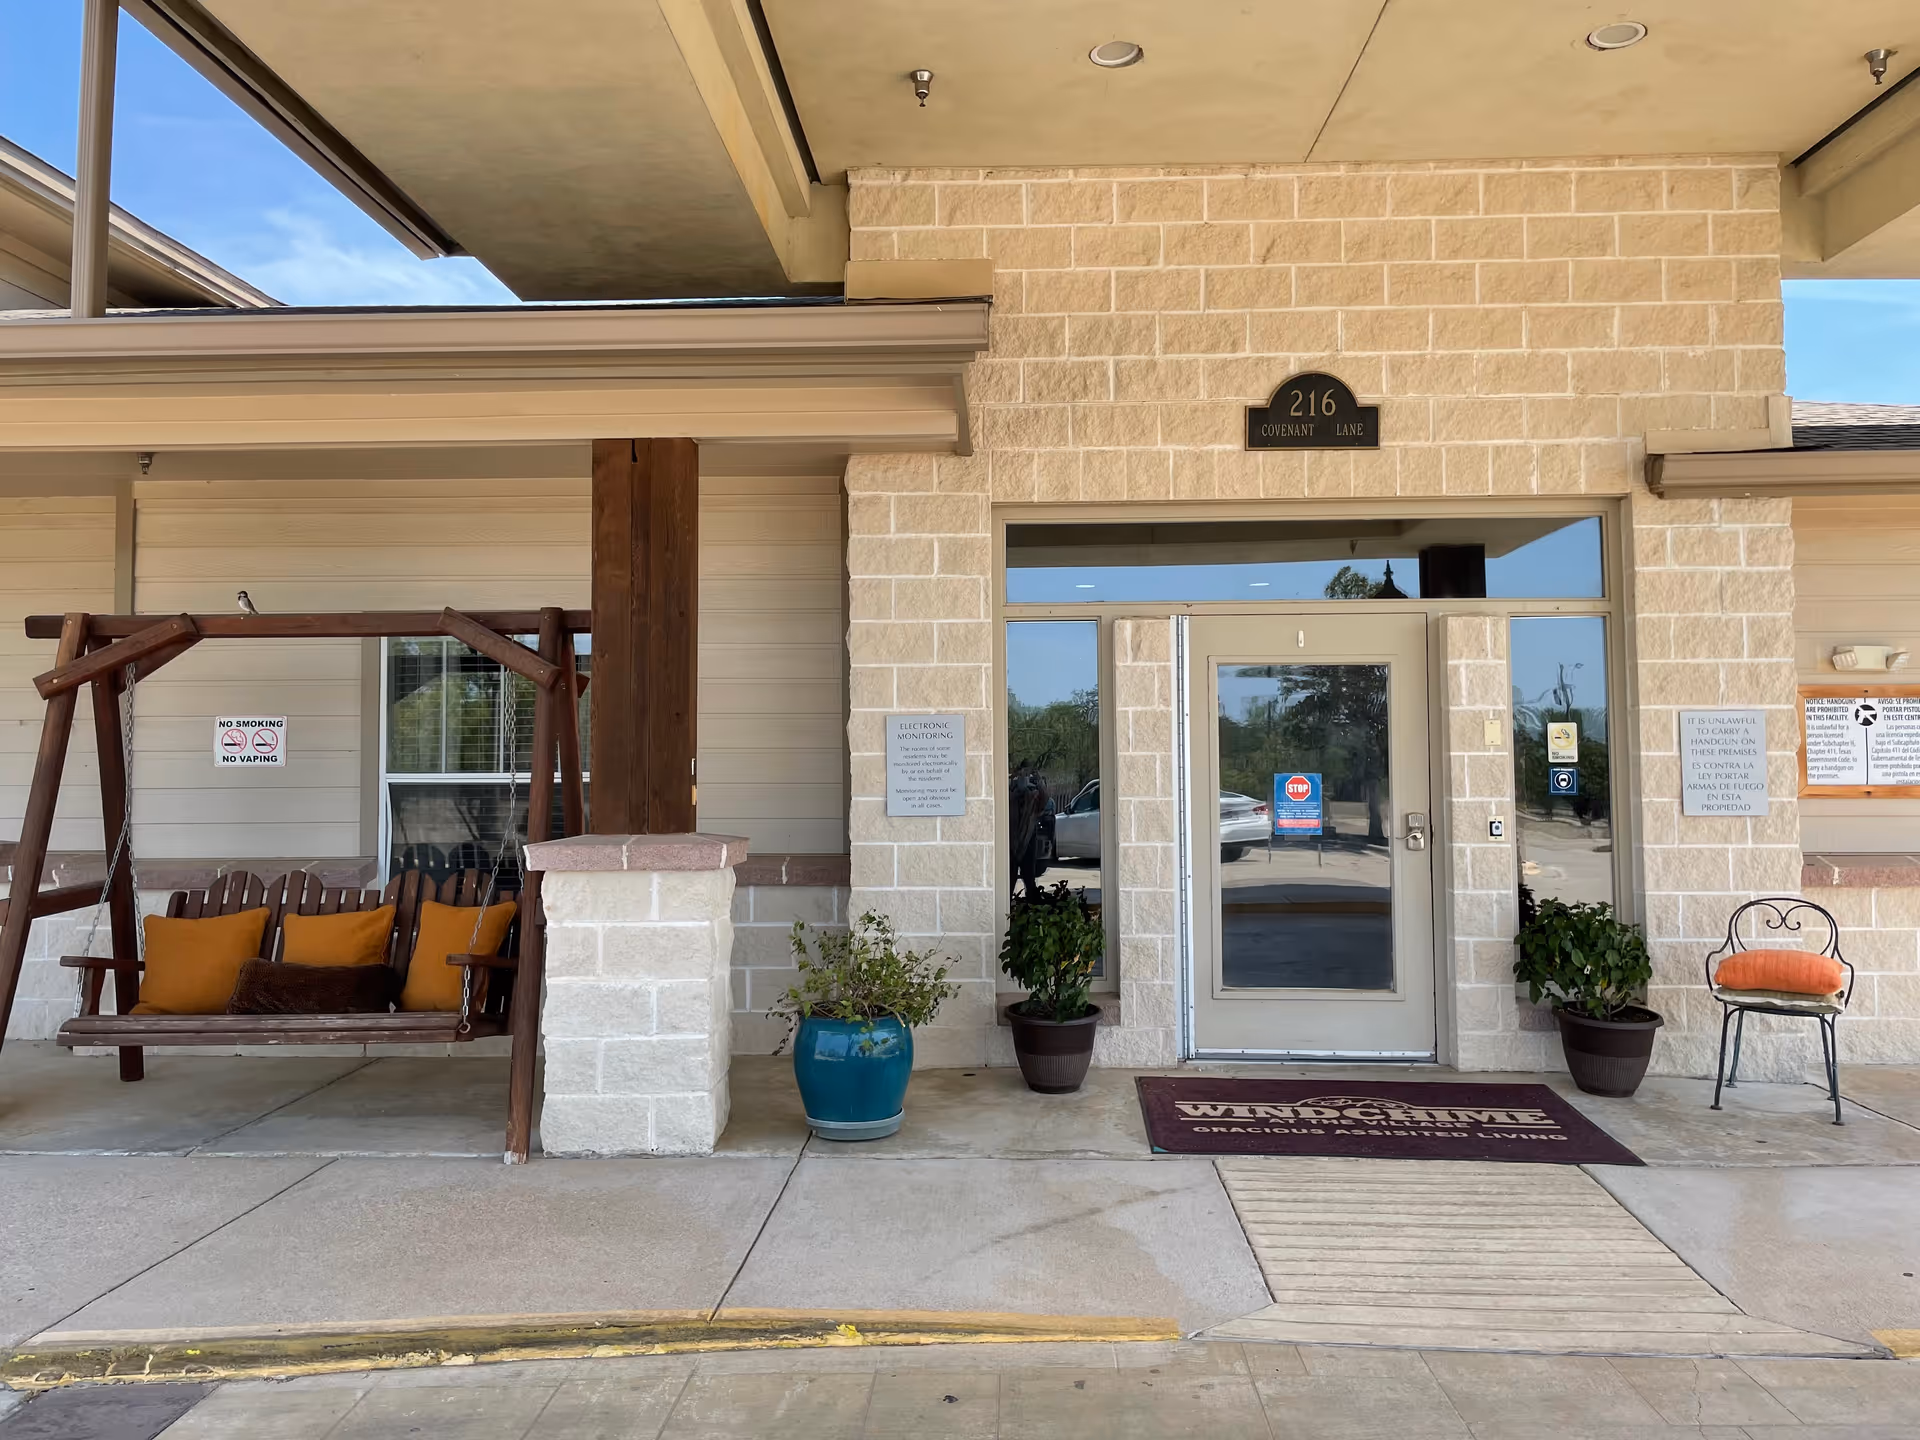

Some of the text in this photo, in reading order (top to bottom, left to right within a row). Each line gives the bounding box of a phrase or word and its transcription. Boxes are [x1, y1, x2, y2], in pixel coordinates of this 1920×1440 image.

[1290, 388, 1336, 416] 216
[1261, 424, 1364, 436] COVENANT LANE
[900, 722, 950, 730] ELECTRONIC
[1288, 784, 1308, 793] STOP
[1174, 1104, 1556, 1124] WINDCHIME
[1362, 1120, 1470, 1128] VILLAGE
[1192, 1126, 1325, 1134] GRACIOUS
[1476, 1132, 1568, 1141] LIVING
